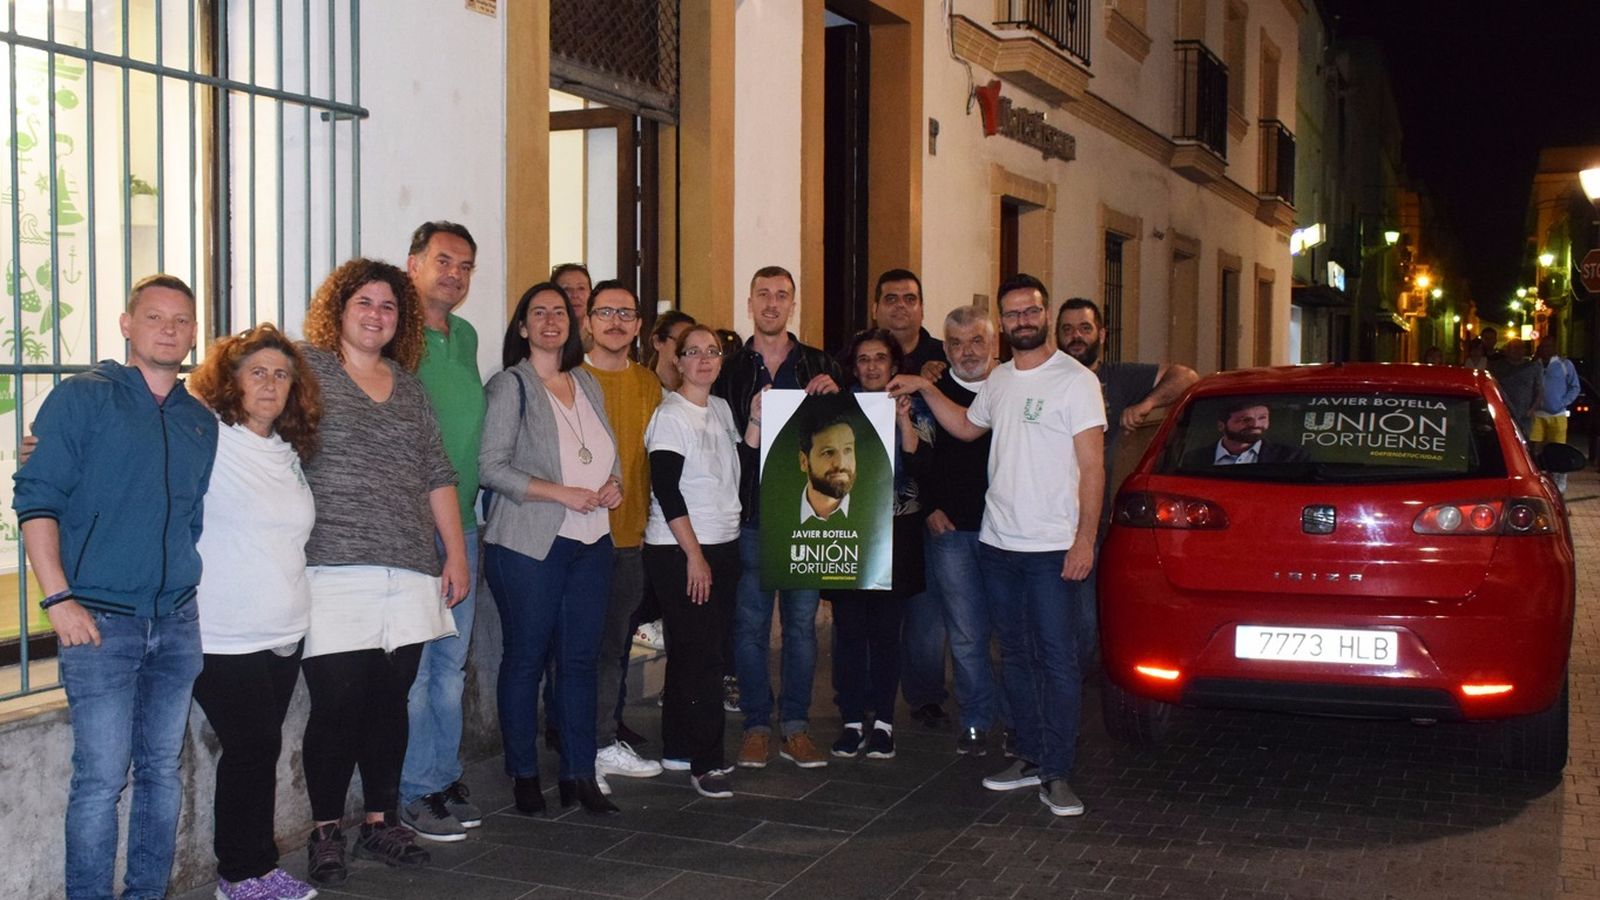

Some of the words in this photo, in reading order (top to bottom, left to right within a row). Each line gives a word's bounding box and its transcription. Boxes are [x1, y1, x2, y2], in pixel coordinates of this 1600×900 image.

[1308, 397, 1367, 406] JAVIER
[1374, 397, 1447, 411] BOTELLA
[1304, 409, 1447, 436] UNIÓN
[1301, 432, 1446, 452] PORTUENSE
[791, 530, 821, 539] JAVIER
[822, 530, 858, 539] BOTELLA
[790, 540, 858, 562] UNIÓN
[790, 562, 858, 574] PORTUENSE
[1274, 571, 1363, 581] IBIZA
[1259, 632, 1323, 657] 7773
[1339, 635, 1389, 660] HLB
